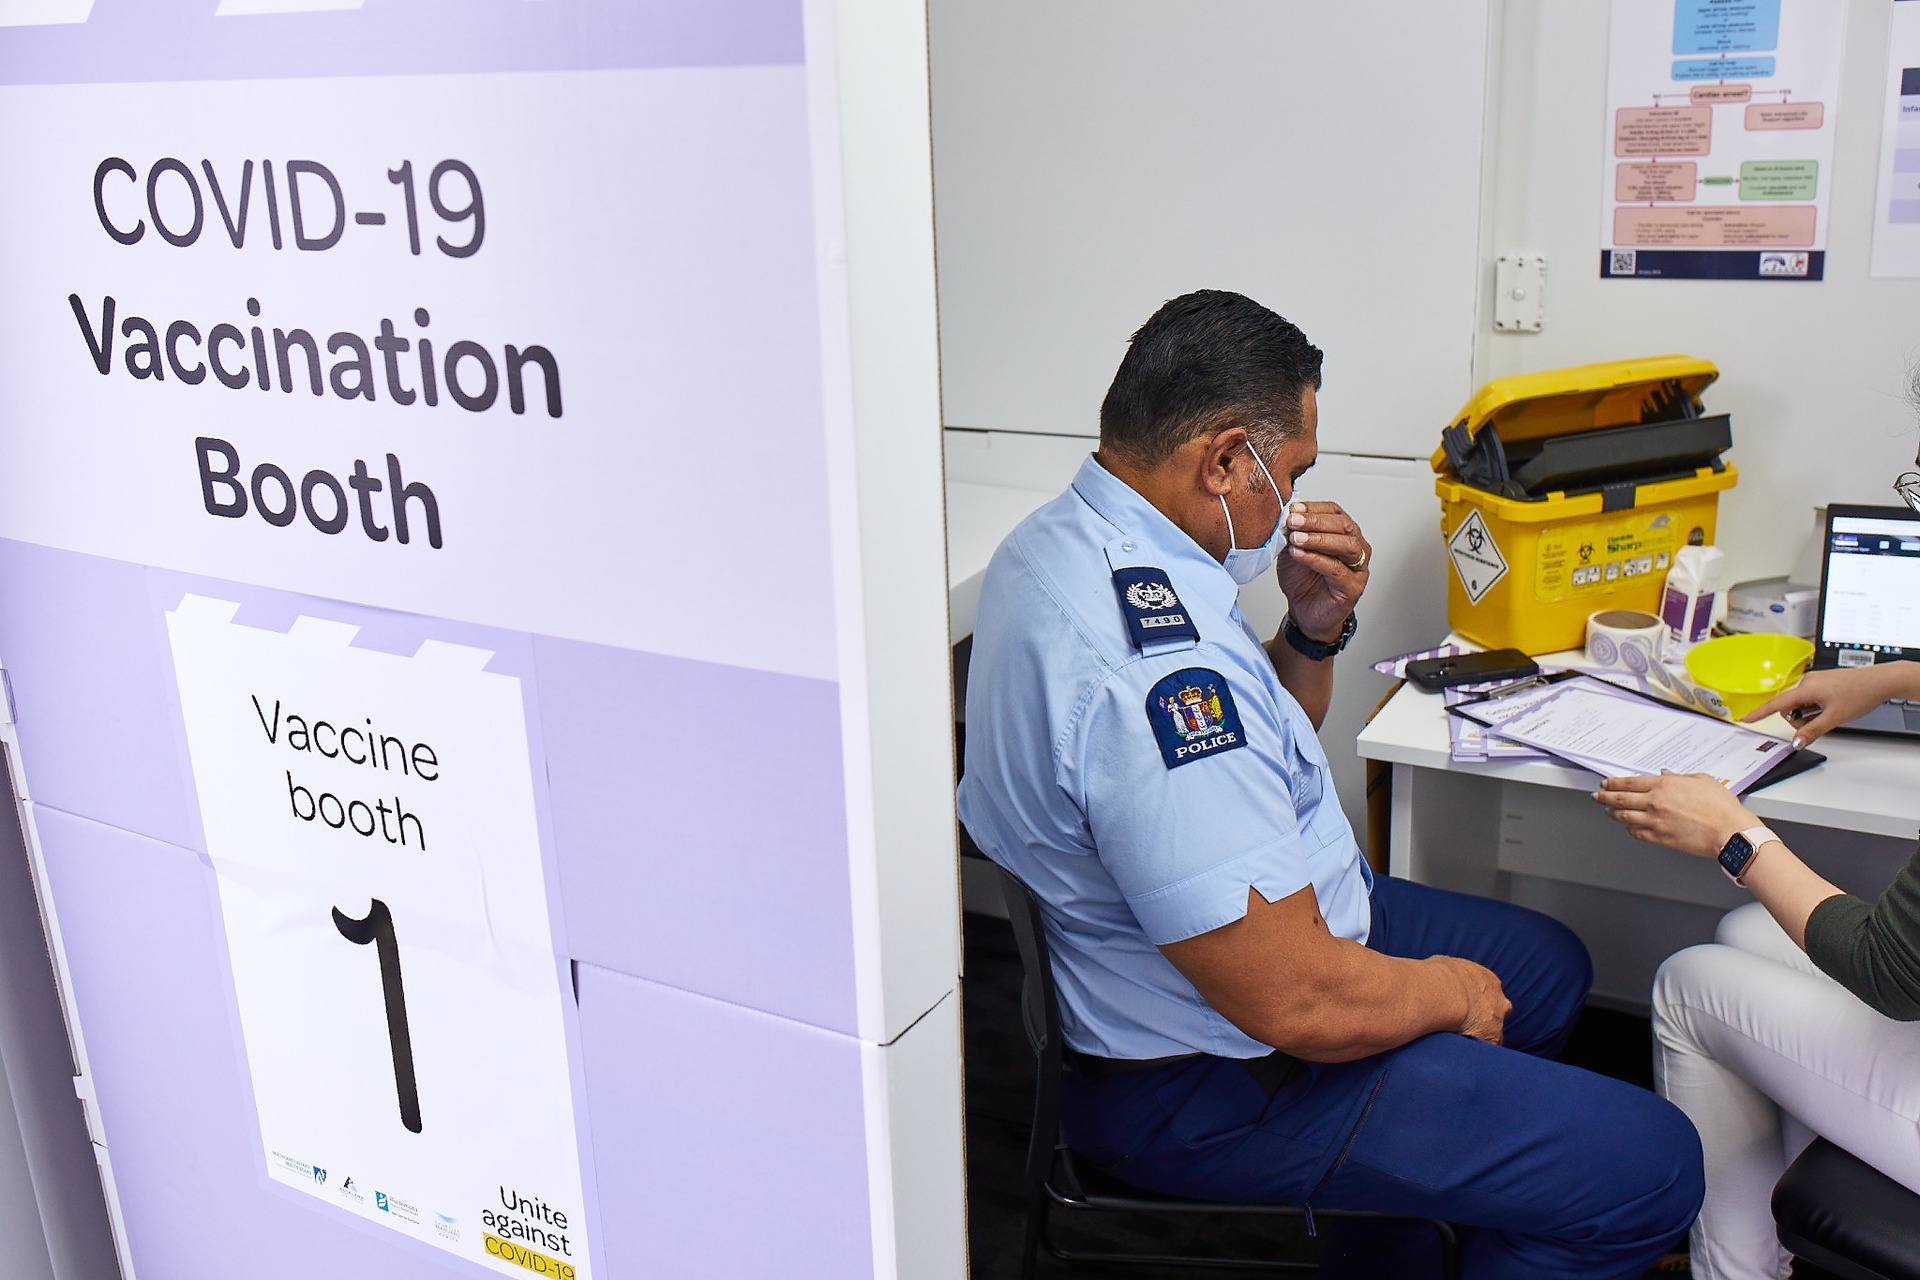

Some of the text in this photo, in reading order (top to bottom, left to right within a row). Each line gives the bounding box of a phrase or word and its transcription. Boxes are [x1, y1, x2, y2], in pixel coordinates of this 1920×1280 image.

[93, 156, 486, 258] COVID-19
[68, 292, 563, 418] Vaccination
[195, 436, 443, 550] Booth
[1143, 615, 1181, 627] 7490
[251, 693, 439, 782] Vaccine
[1174, 731, 1238, 759] POLICE
[285, 769, 427, 852] booth
[331, 896, 423, 1134] 1
[482, 1209, 572, 1257] against
[500, 1185, 568, 1230] Unite
[485, 1236, 575, 1280] COVID-19
